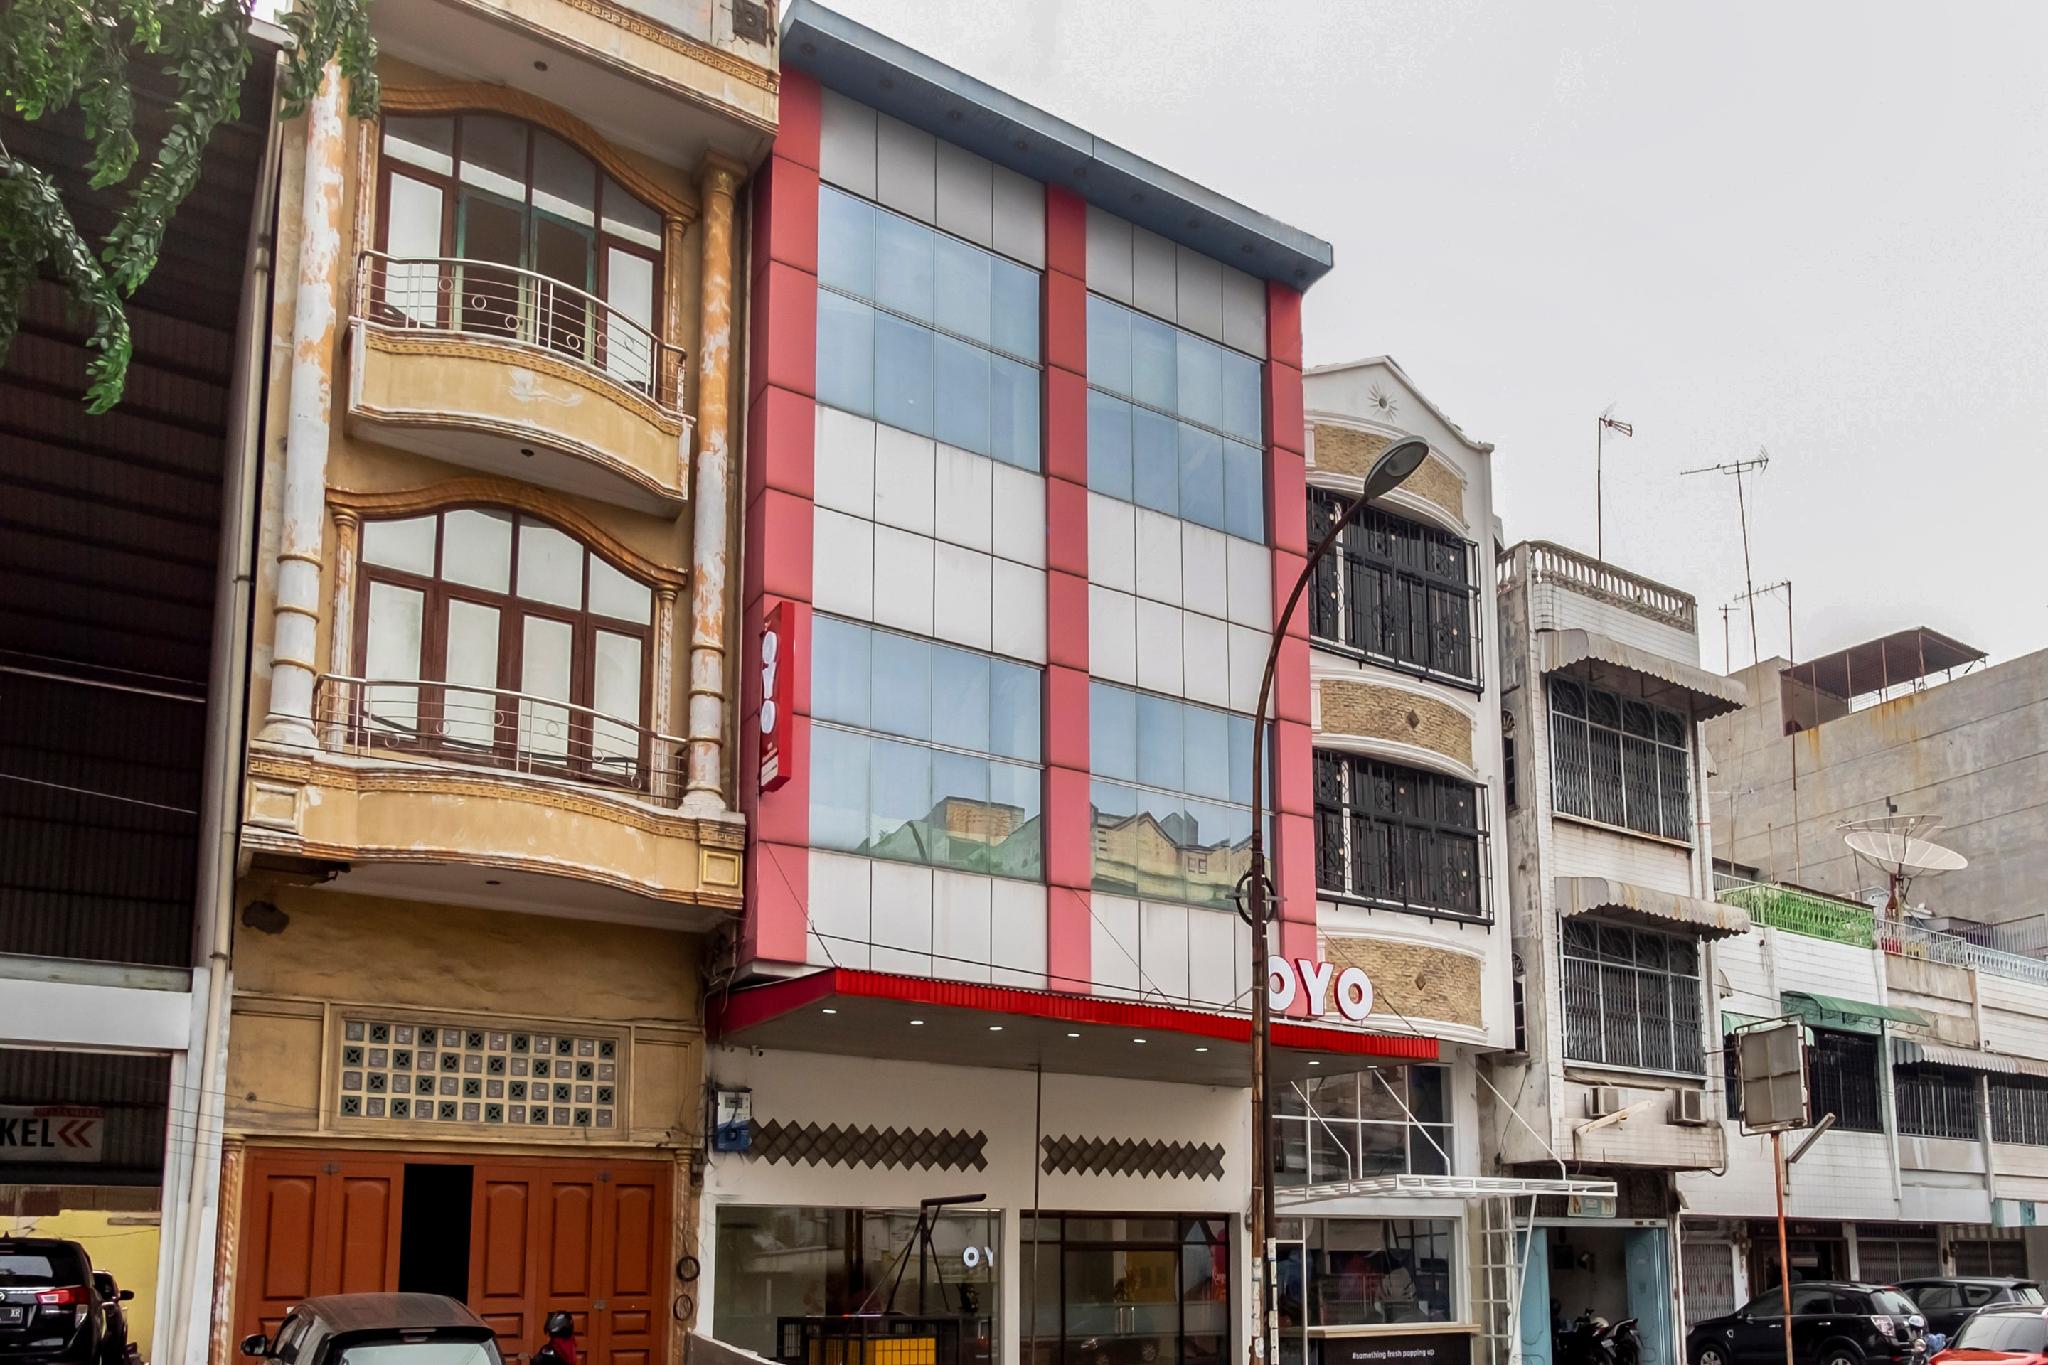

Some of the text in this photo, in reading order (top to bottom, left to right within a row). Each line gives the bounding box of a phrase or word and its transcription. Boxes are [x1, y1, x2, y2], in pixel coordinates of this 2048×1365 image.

[761, 631, 777, 734] OYO
[1268, 955, 1373, 1021] OYO
[0, 1118, 55, 1147] KEL
[1352, 1348, 1435, 1360] #something fresh popping up
